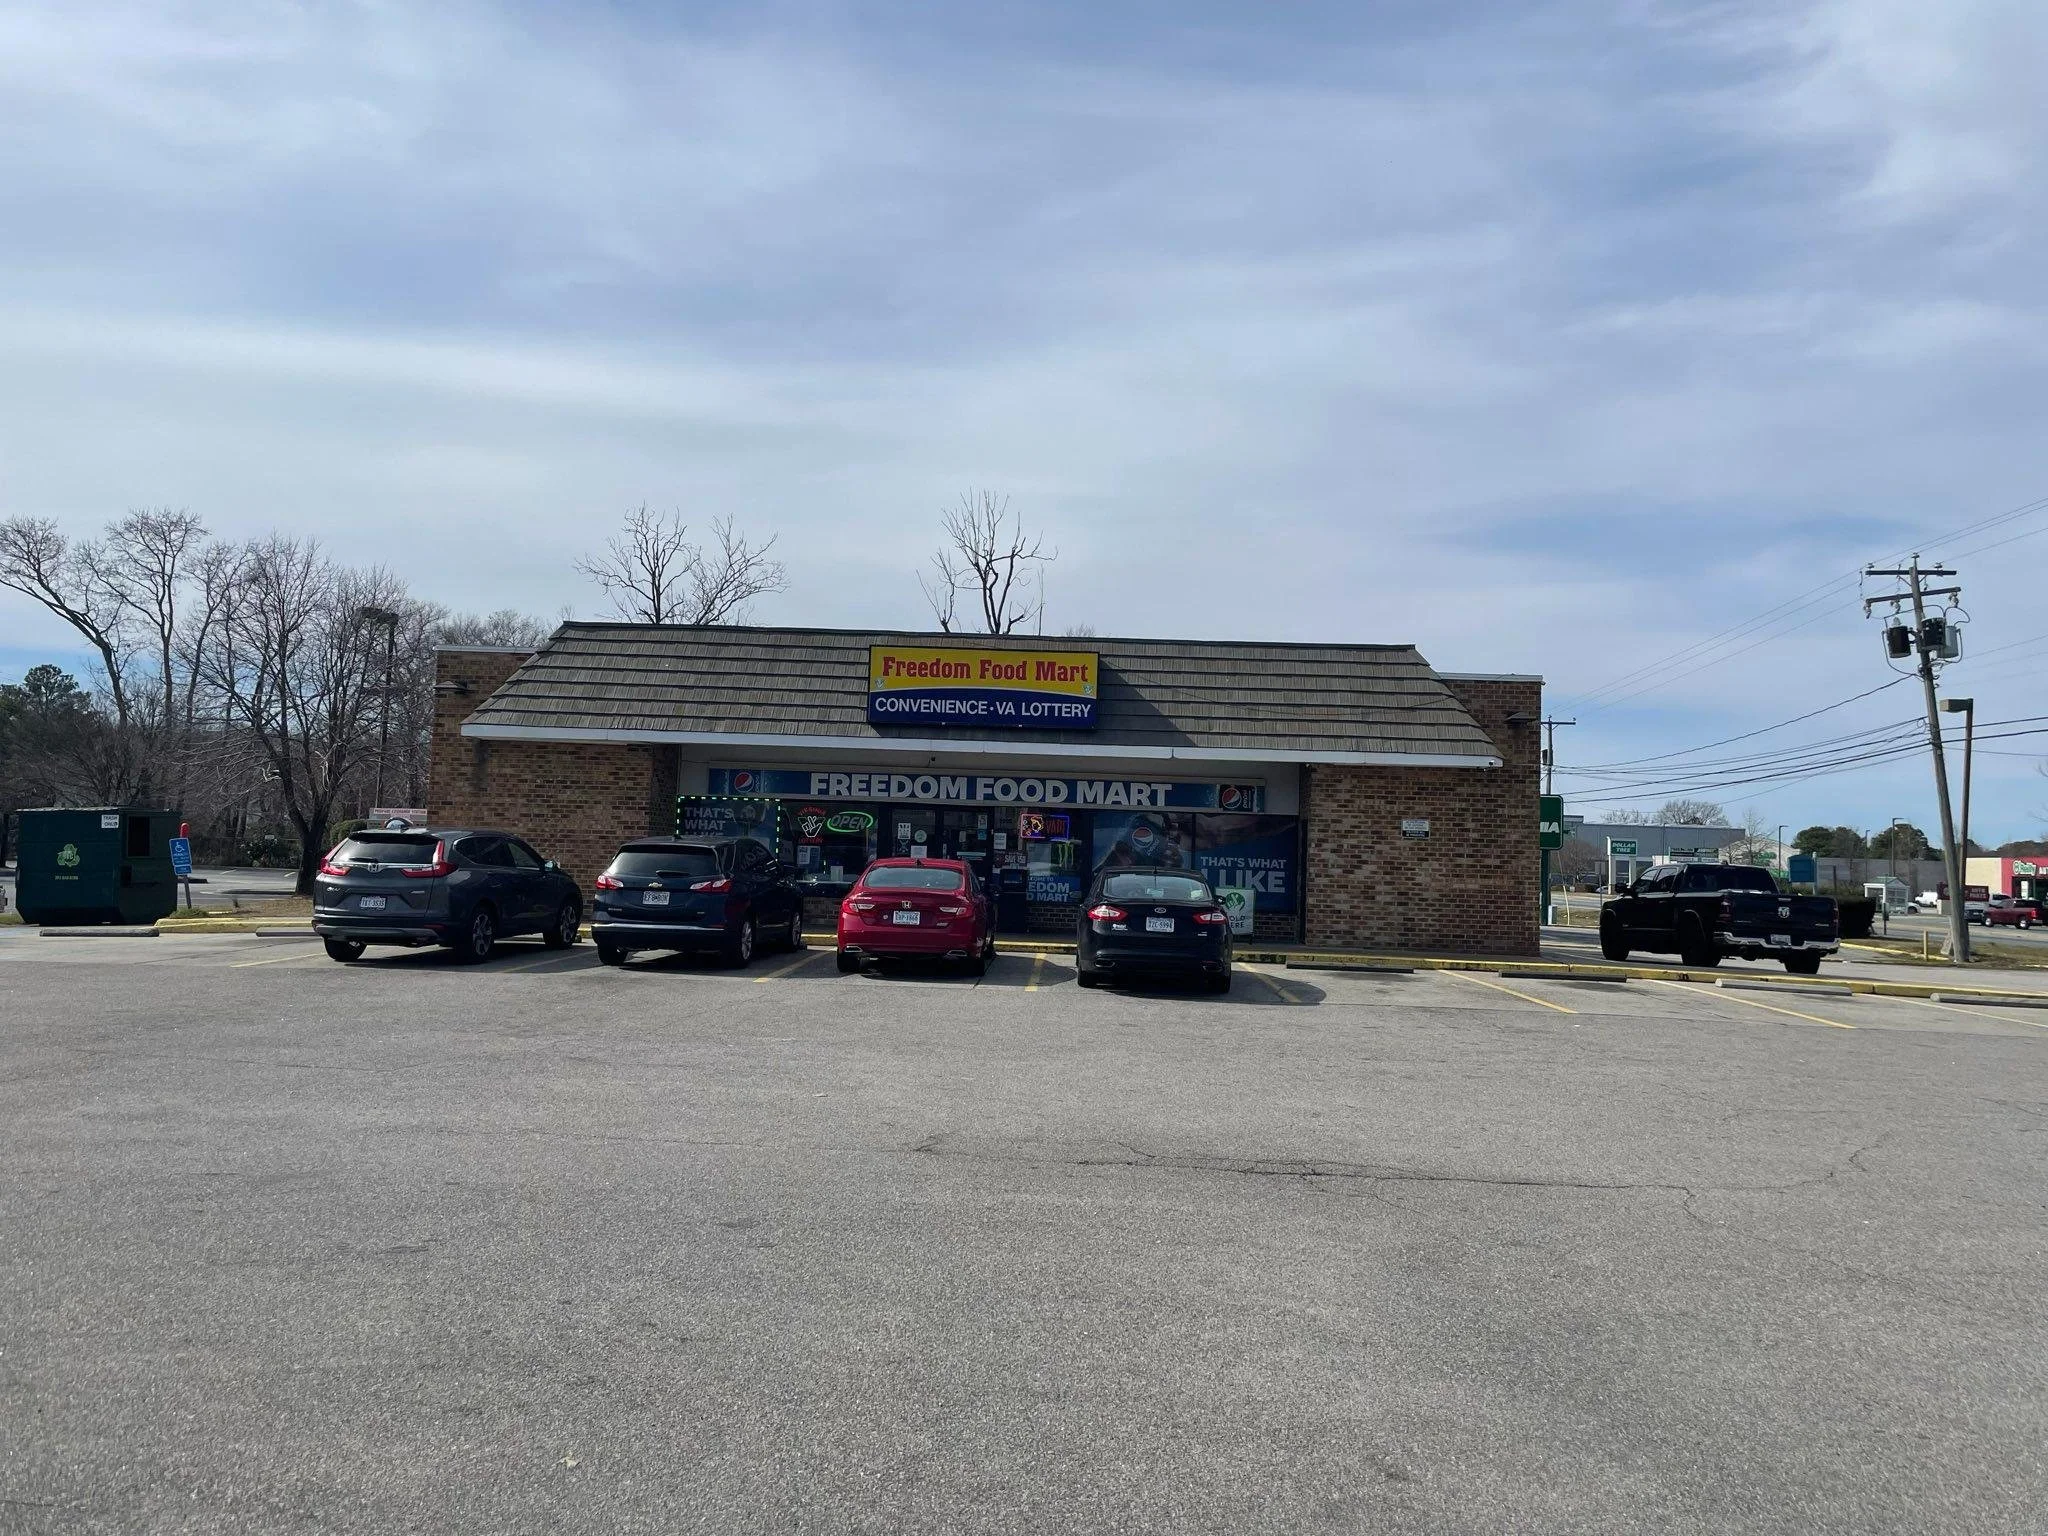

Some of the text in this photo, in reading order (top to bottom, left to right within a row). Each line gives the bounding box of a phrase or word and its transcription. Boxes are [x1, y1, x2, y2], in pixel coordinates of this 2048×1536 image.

[882, 656, 1089, 682] Freedom Food Mart
[996, 701, 1015, 715] VA
[1021, 702, 1091, 718] LOTTERY
[810, 773, 1173, 807] FREEDOM FOOD MART
[684, 819, 726, 831] WHAT
[830, 814, 869, 830] OPEN
[1200, 856, 1287, 869] THAT'S WHAT
[1220, 869, 1286, 894] LIKE
[1036, 892, 1069, 902] MART
